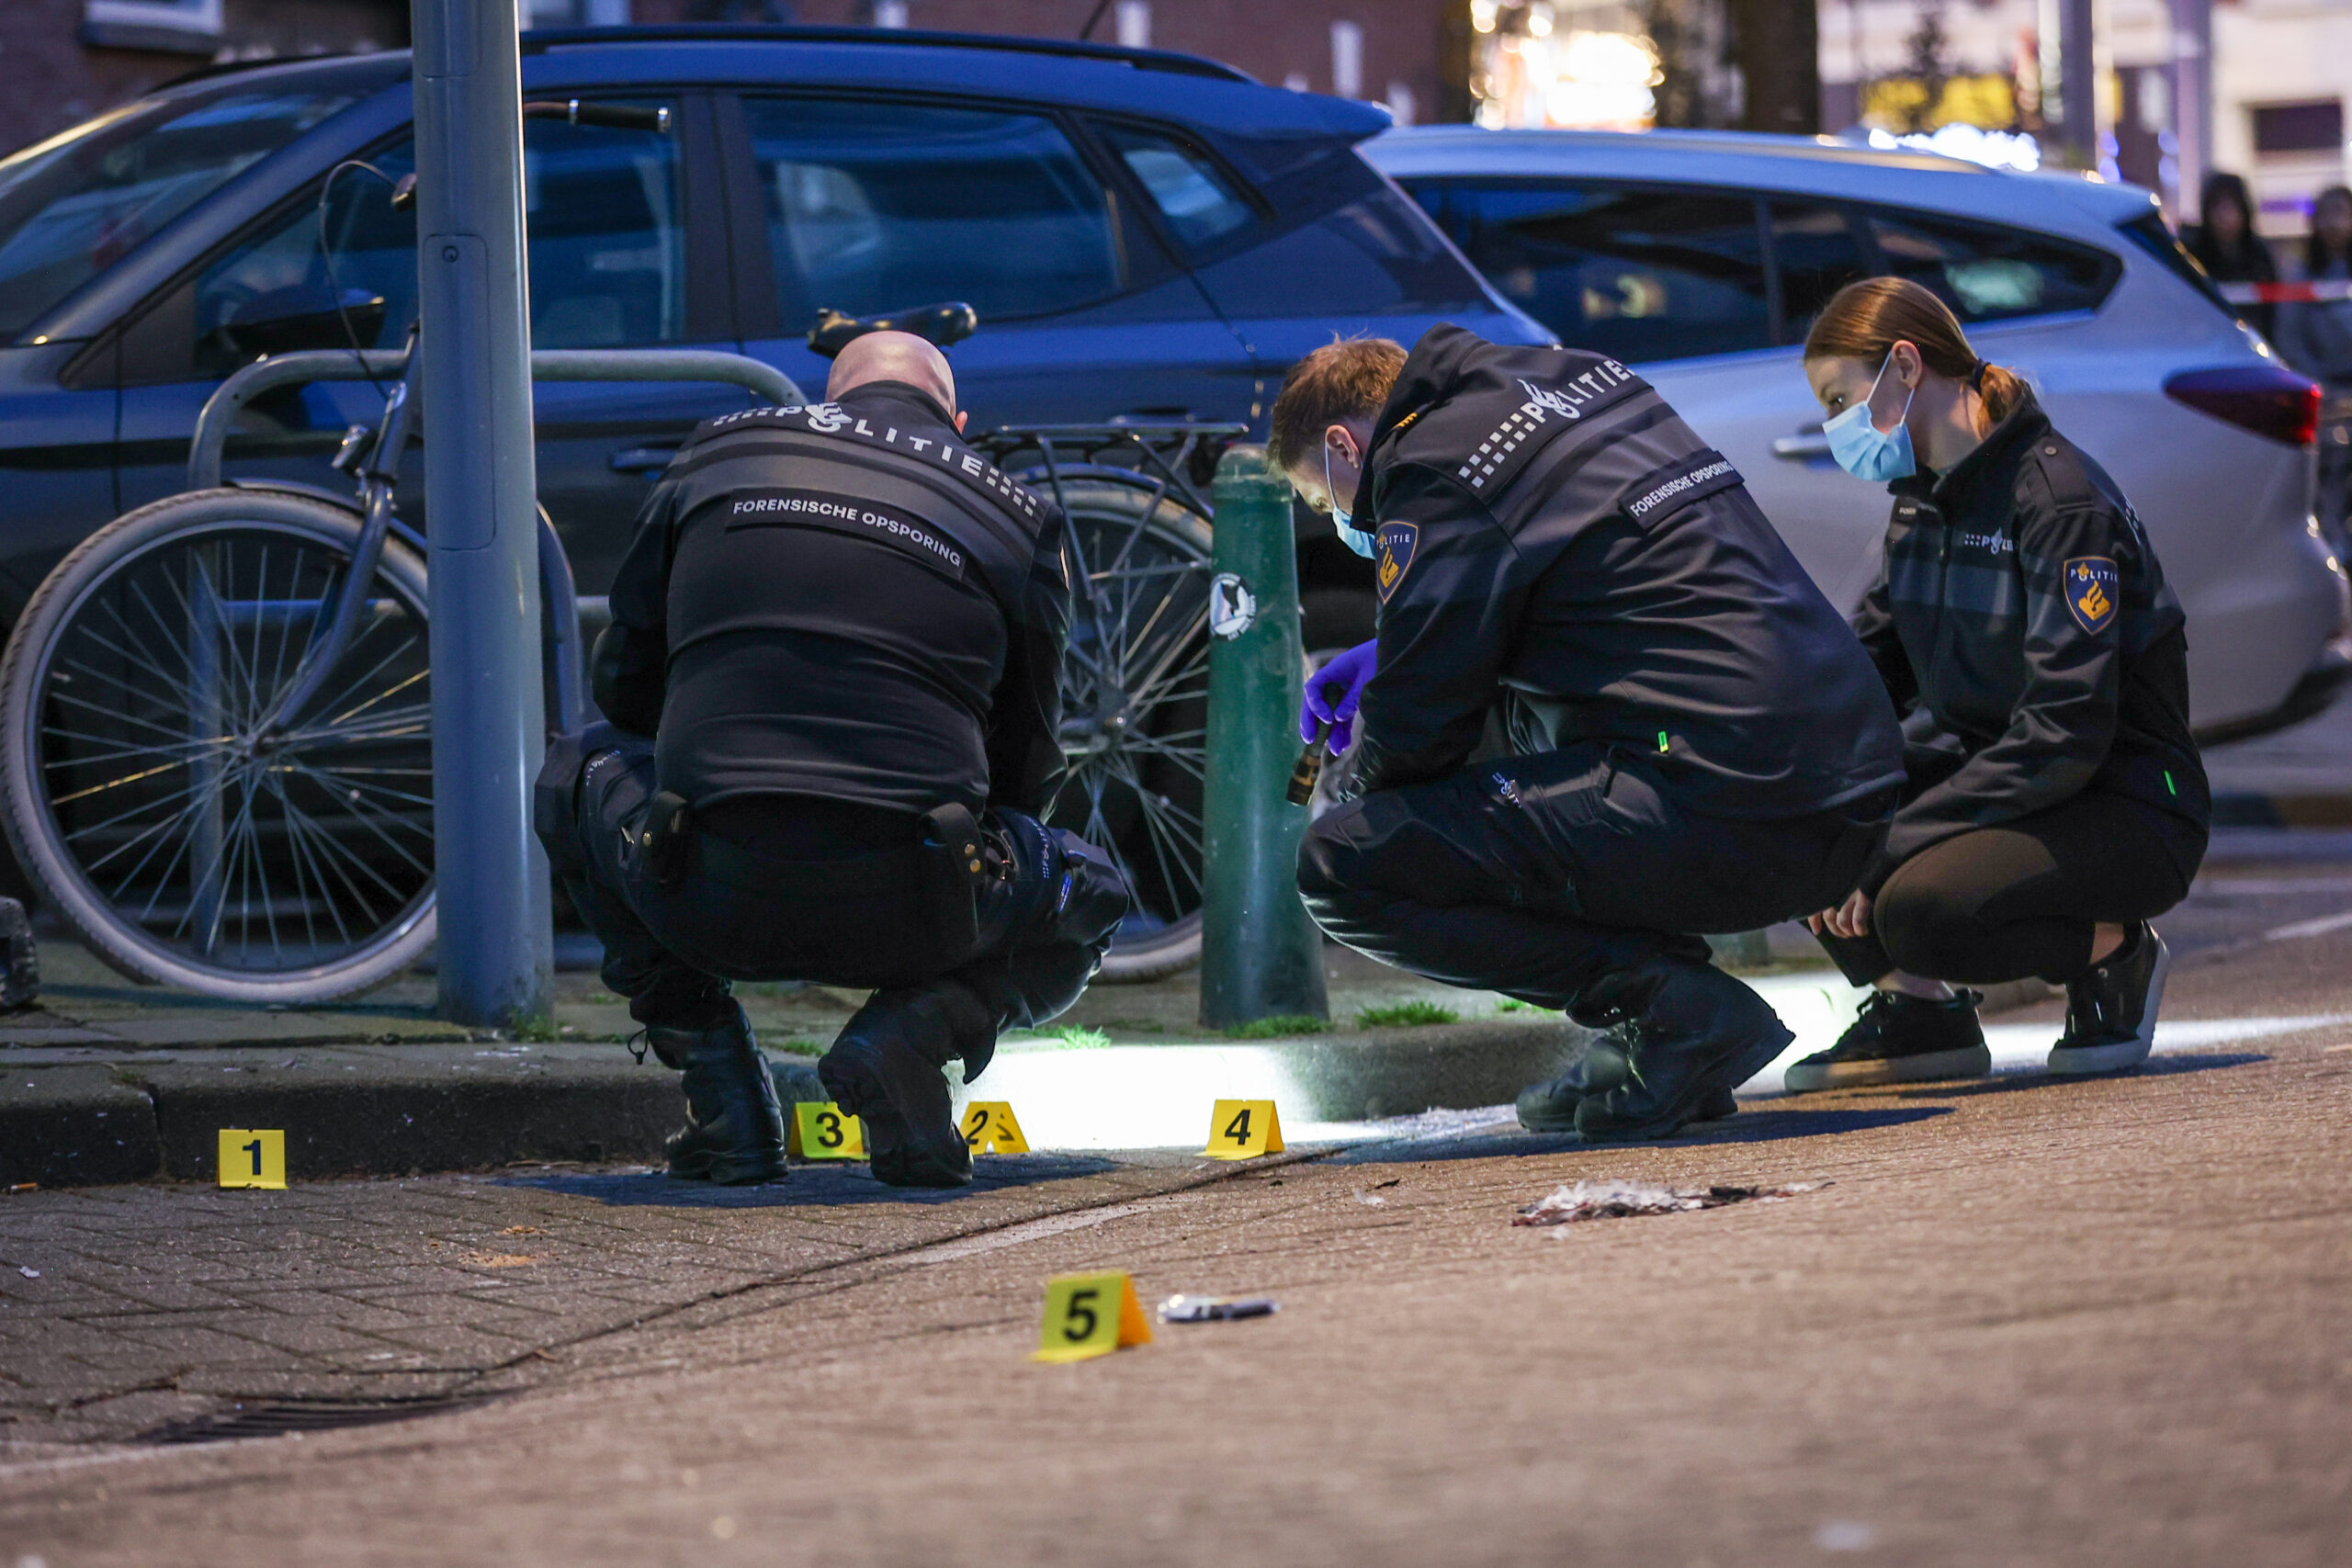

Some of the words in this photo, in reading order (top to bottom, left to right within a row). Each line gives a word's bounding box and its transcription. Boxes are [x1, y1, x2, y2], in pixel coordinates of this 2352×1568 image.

[1629, 475, 1695, 518] FORENSISCHE
[732, 499, 858, 522] FORENSISCHE
[862, 512, 963, 568] OPSPORING
[815, 1111, 844, 1149] 3
[966, 1109, 989, 1146] 2
[1224, 1108, 1252, 1146] 4
[242, 1138, 262, 1176] 1
[1062, 1289, 1099, 1342] 5
